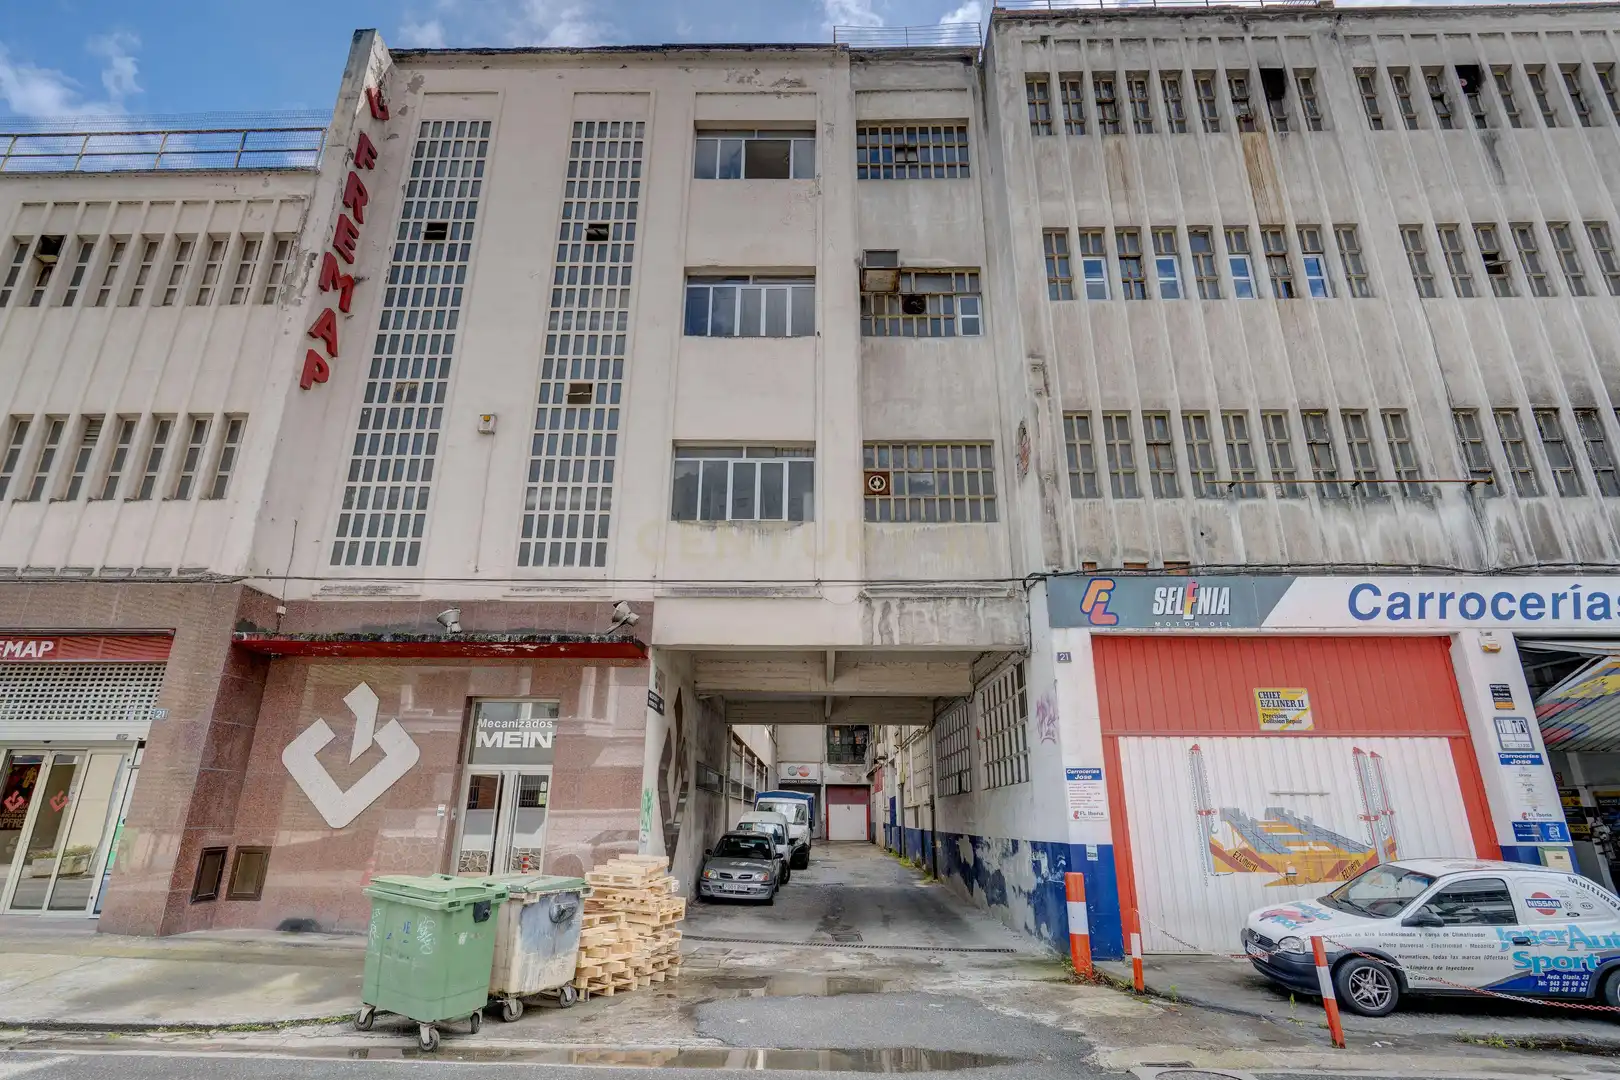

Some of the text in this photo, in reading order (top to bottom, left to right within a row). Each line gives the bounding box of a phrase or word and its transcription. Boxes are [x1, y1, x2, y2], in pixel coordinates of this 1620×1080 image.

[1153, 580, 1231, 620] SELENIA
[1348, 583, 1620, 621] Carrocería
[1059, 653, 1069, 661] 21
[1258, 691, 1281, 699] CHIEF
[156, 710, 166, 718] 21
[477, 718, 553, 728] Mecanizados
[476, 731, 553, 748] MEIN
[1527, 900, 1560, 908] NISSAN
[1512, 951, 1600, 976] Sport
